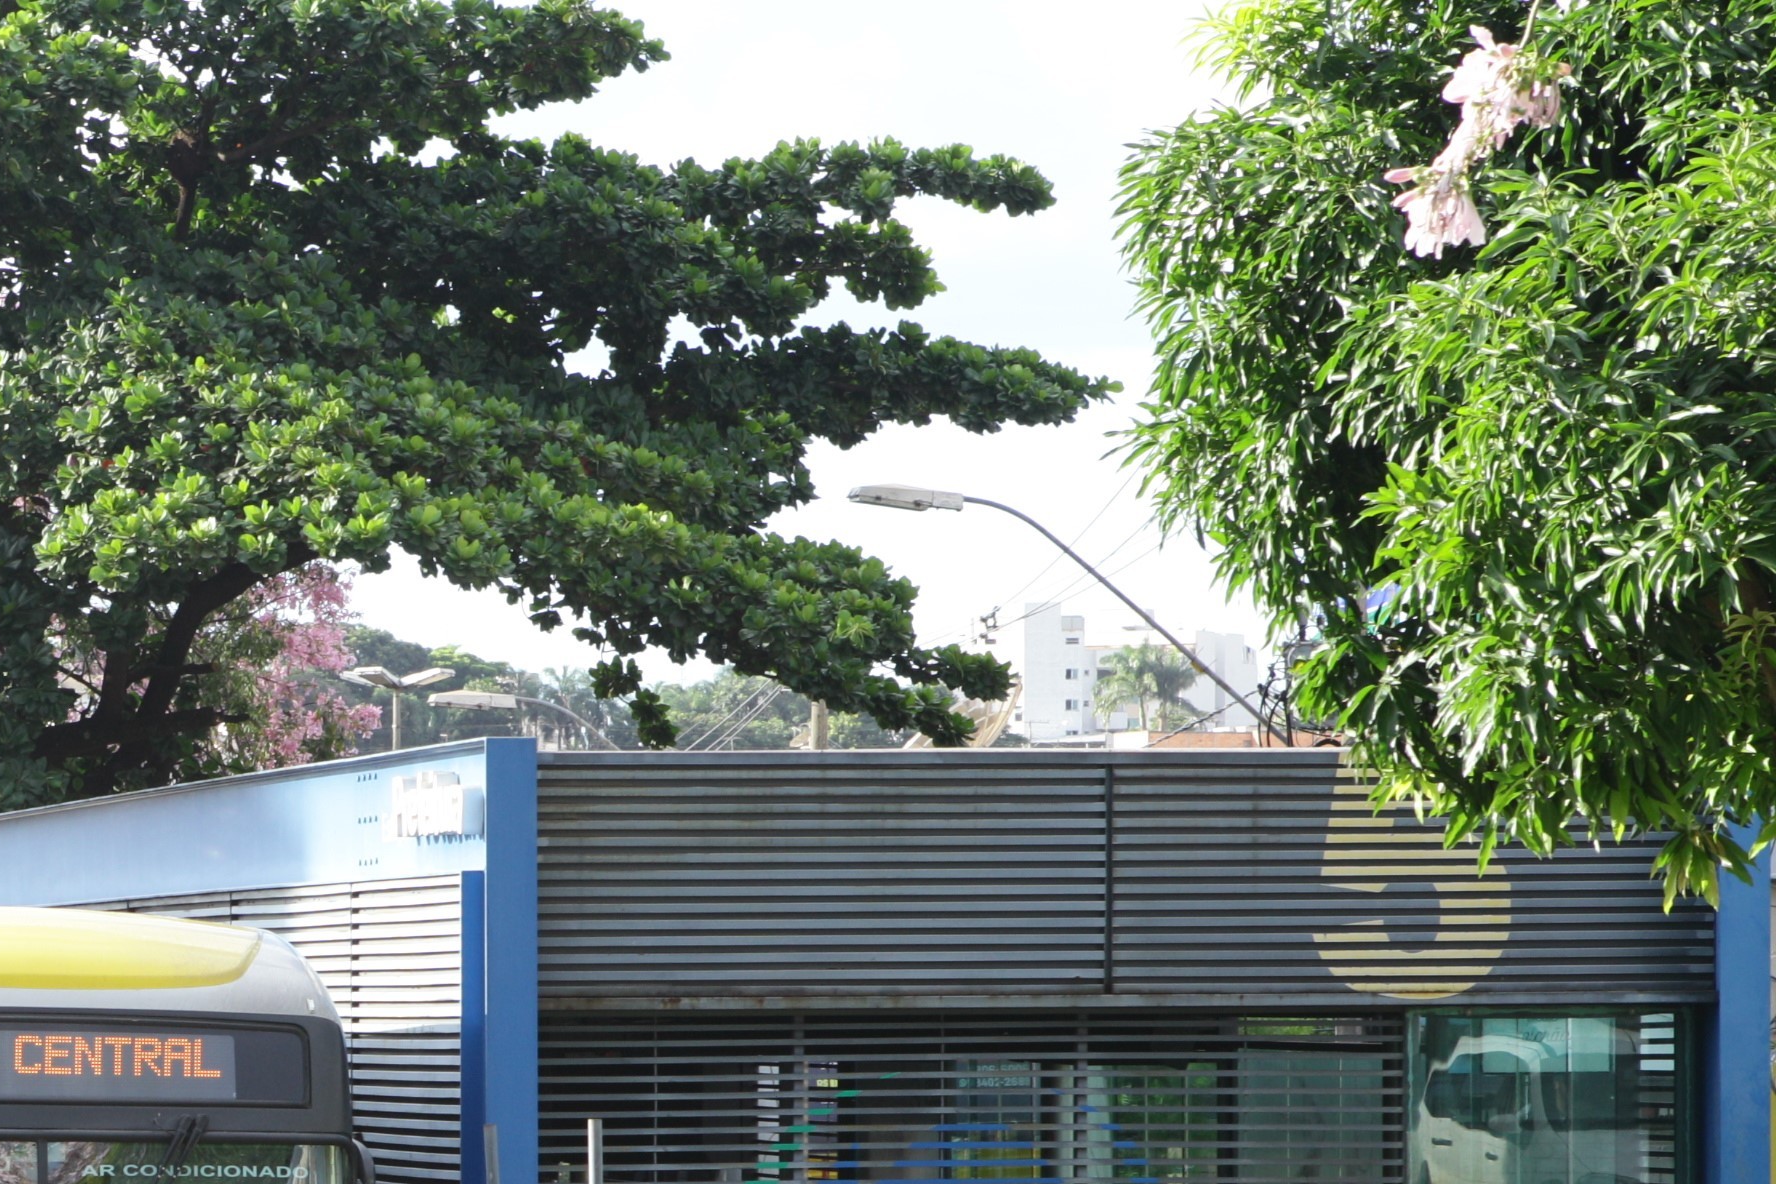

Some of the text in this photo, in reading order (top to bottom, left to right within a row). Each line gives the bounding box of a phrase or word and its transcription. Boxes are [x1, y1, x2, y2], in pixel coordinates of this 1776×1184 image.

[1312, 752, 1511, 999] 5
[14, 1035, 221, 1078] CENTRAL
[81, 1164, 309, 1179] AR CONDICIONADO
